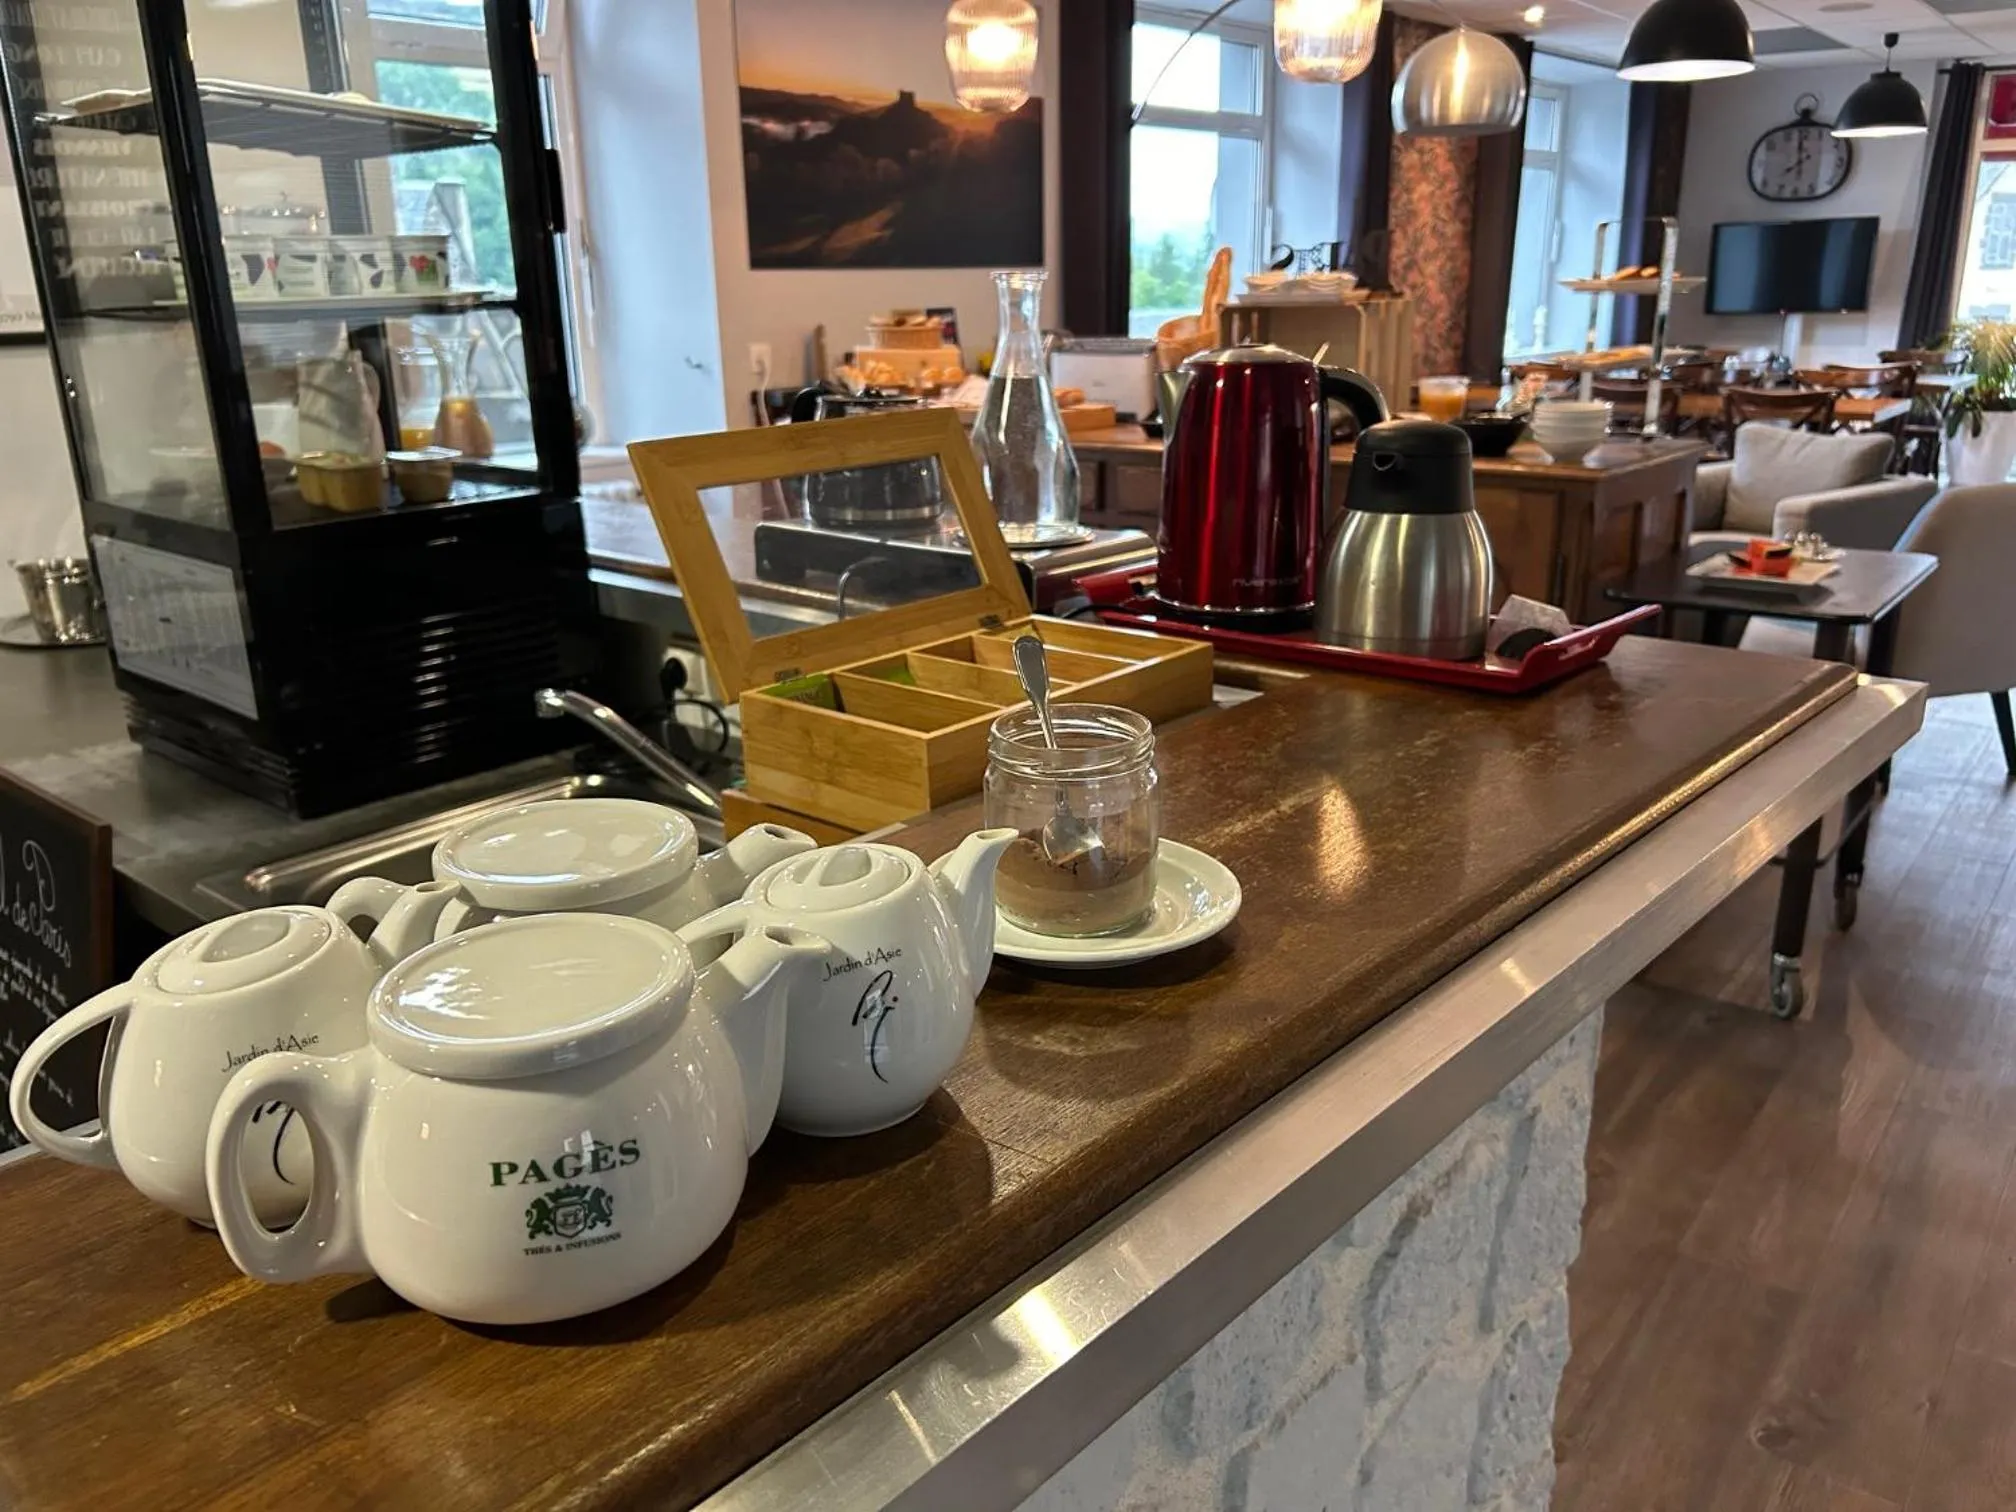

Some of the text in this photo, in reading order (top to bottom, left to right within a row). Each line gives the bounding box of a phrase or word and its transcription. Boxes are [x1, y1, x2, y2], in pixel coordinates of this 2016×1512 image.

[823, 946, 903, 982] Jardin d'Asie
[221, 1034, 320, 1073] Jardin d'Asie
[488, 1139, 641, 1187] PAGÈS
[554, 1243, 563, 1253] &
[565, 1231, 622, 1250] INFUSIONS
